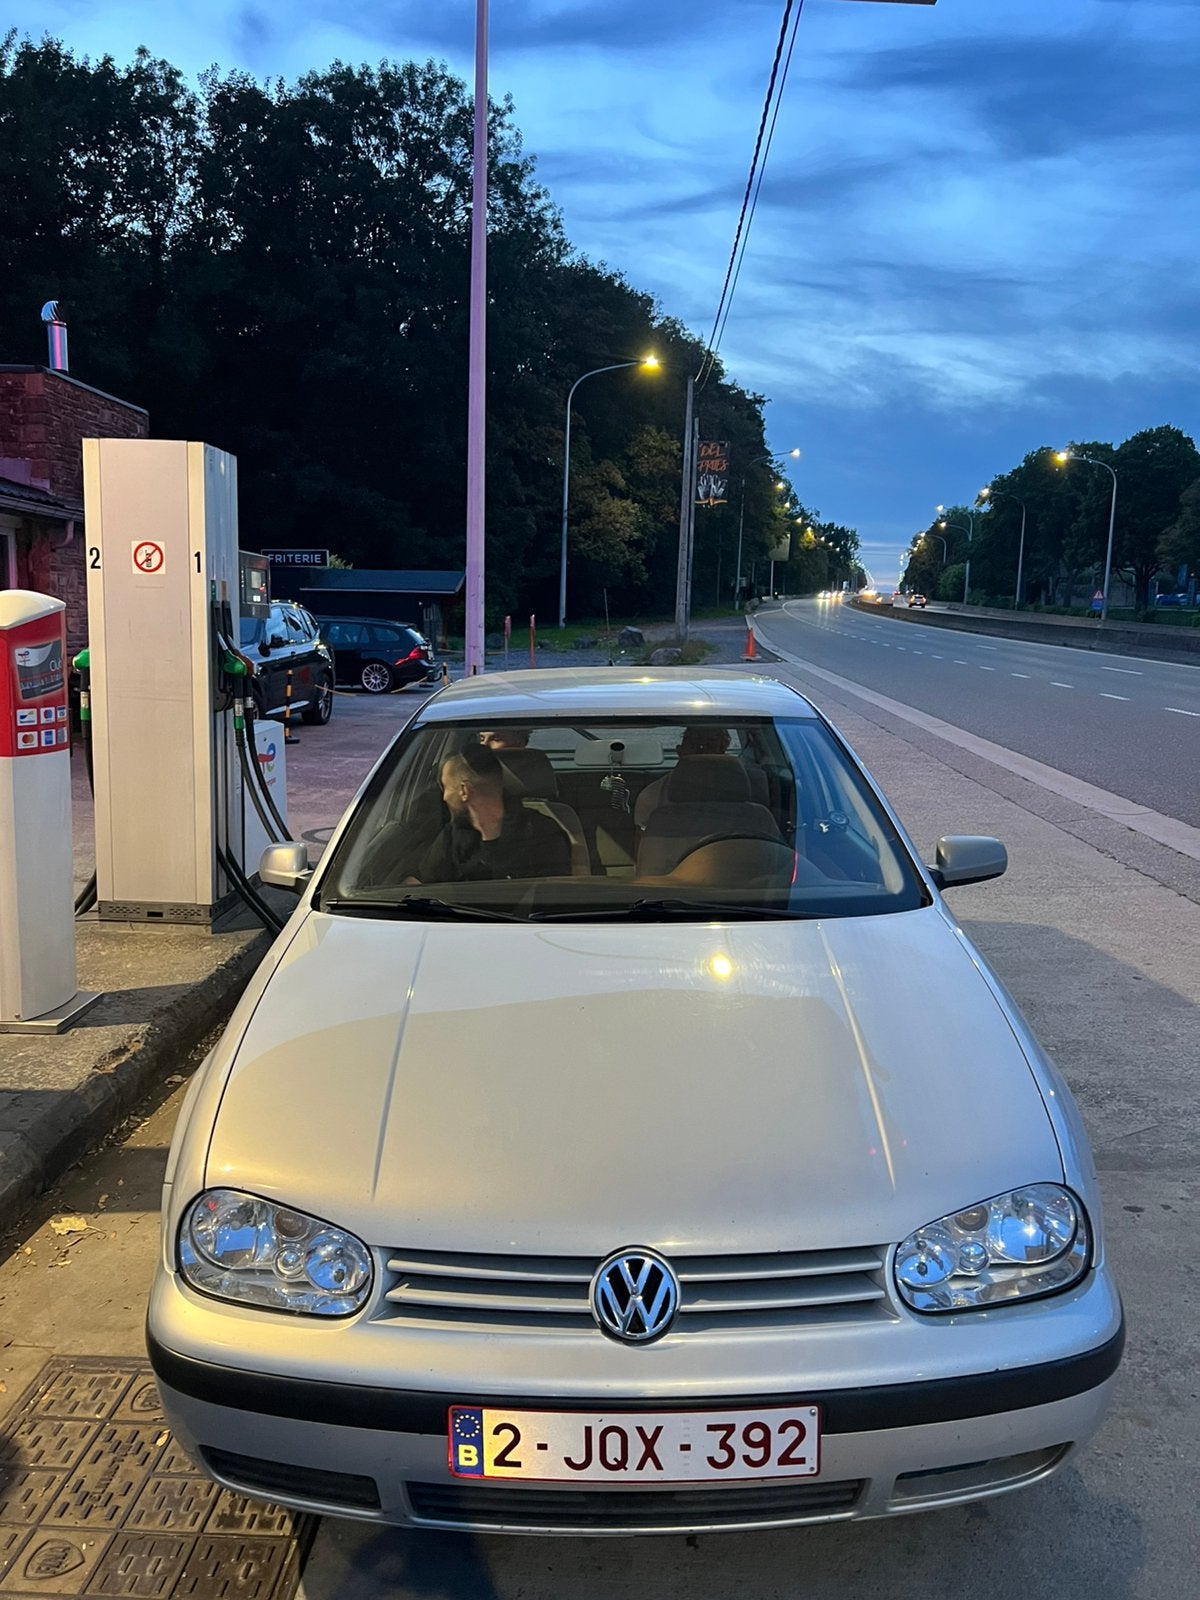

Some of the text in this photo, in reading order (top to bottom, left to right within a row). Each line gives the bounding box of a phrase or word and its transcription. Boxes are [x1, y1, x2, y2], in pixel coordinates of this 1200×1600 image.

[89, 546, 101, 569] 2
[194, 551, 201, 573] 1
[268, 554, 322, 563] FRITERIE
[458, 1444, 478, 1466] B
